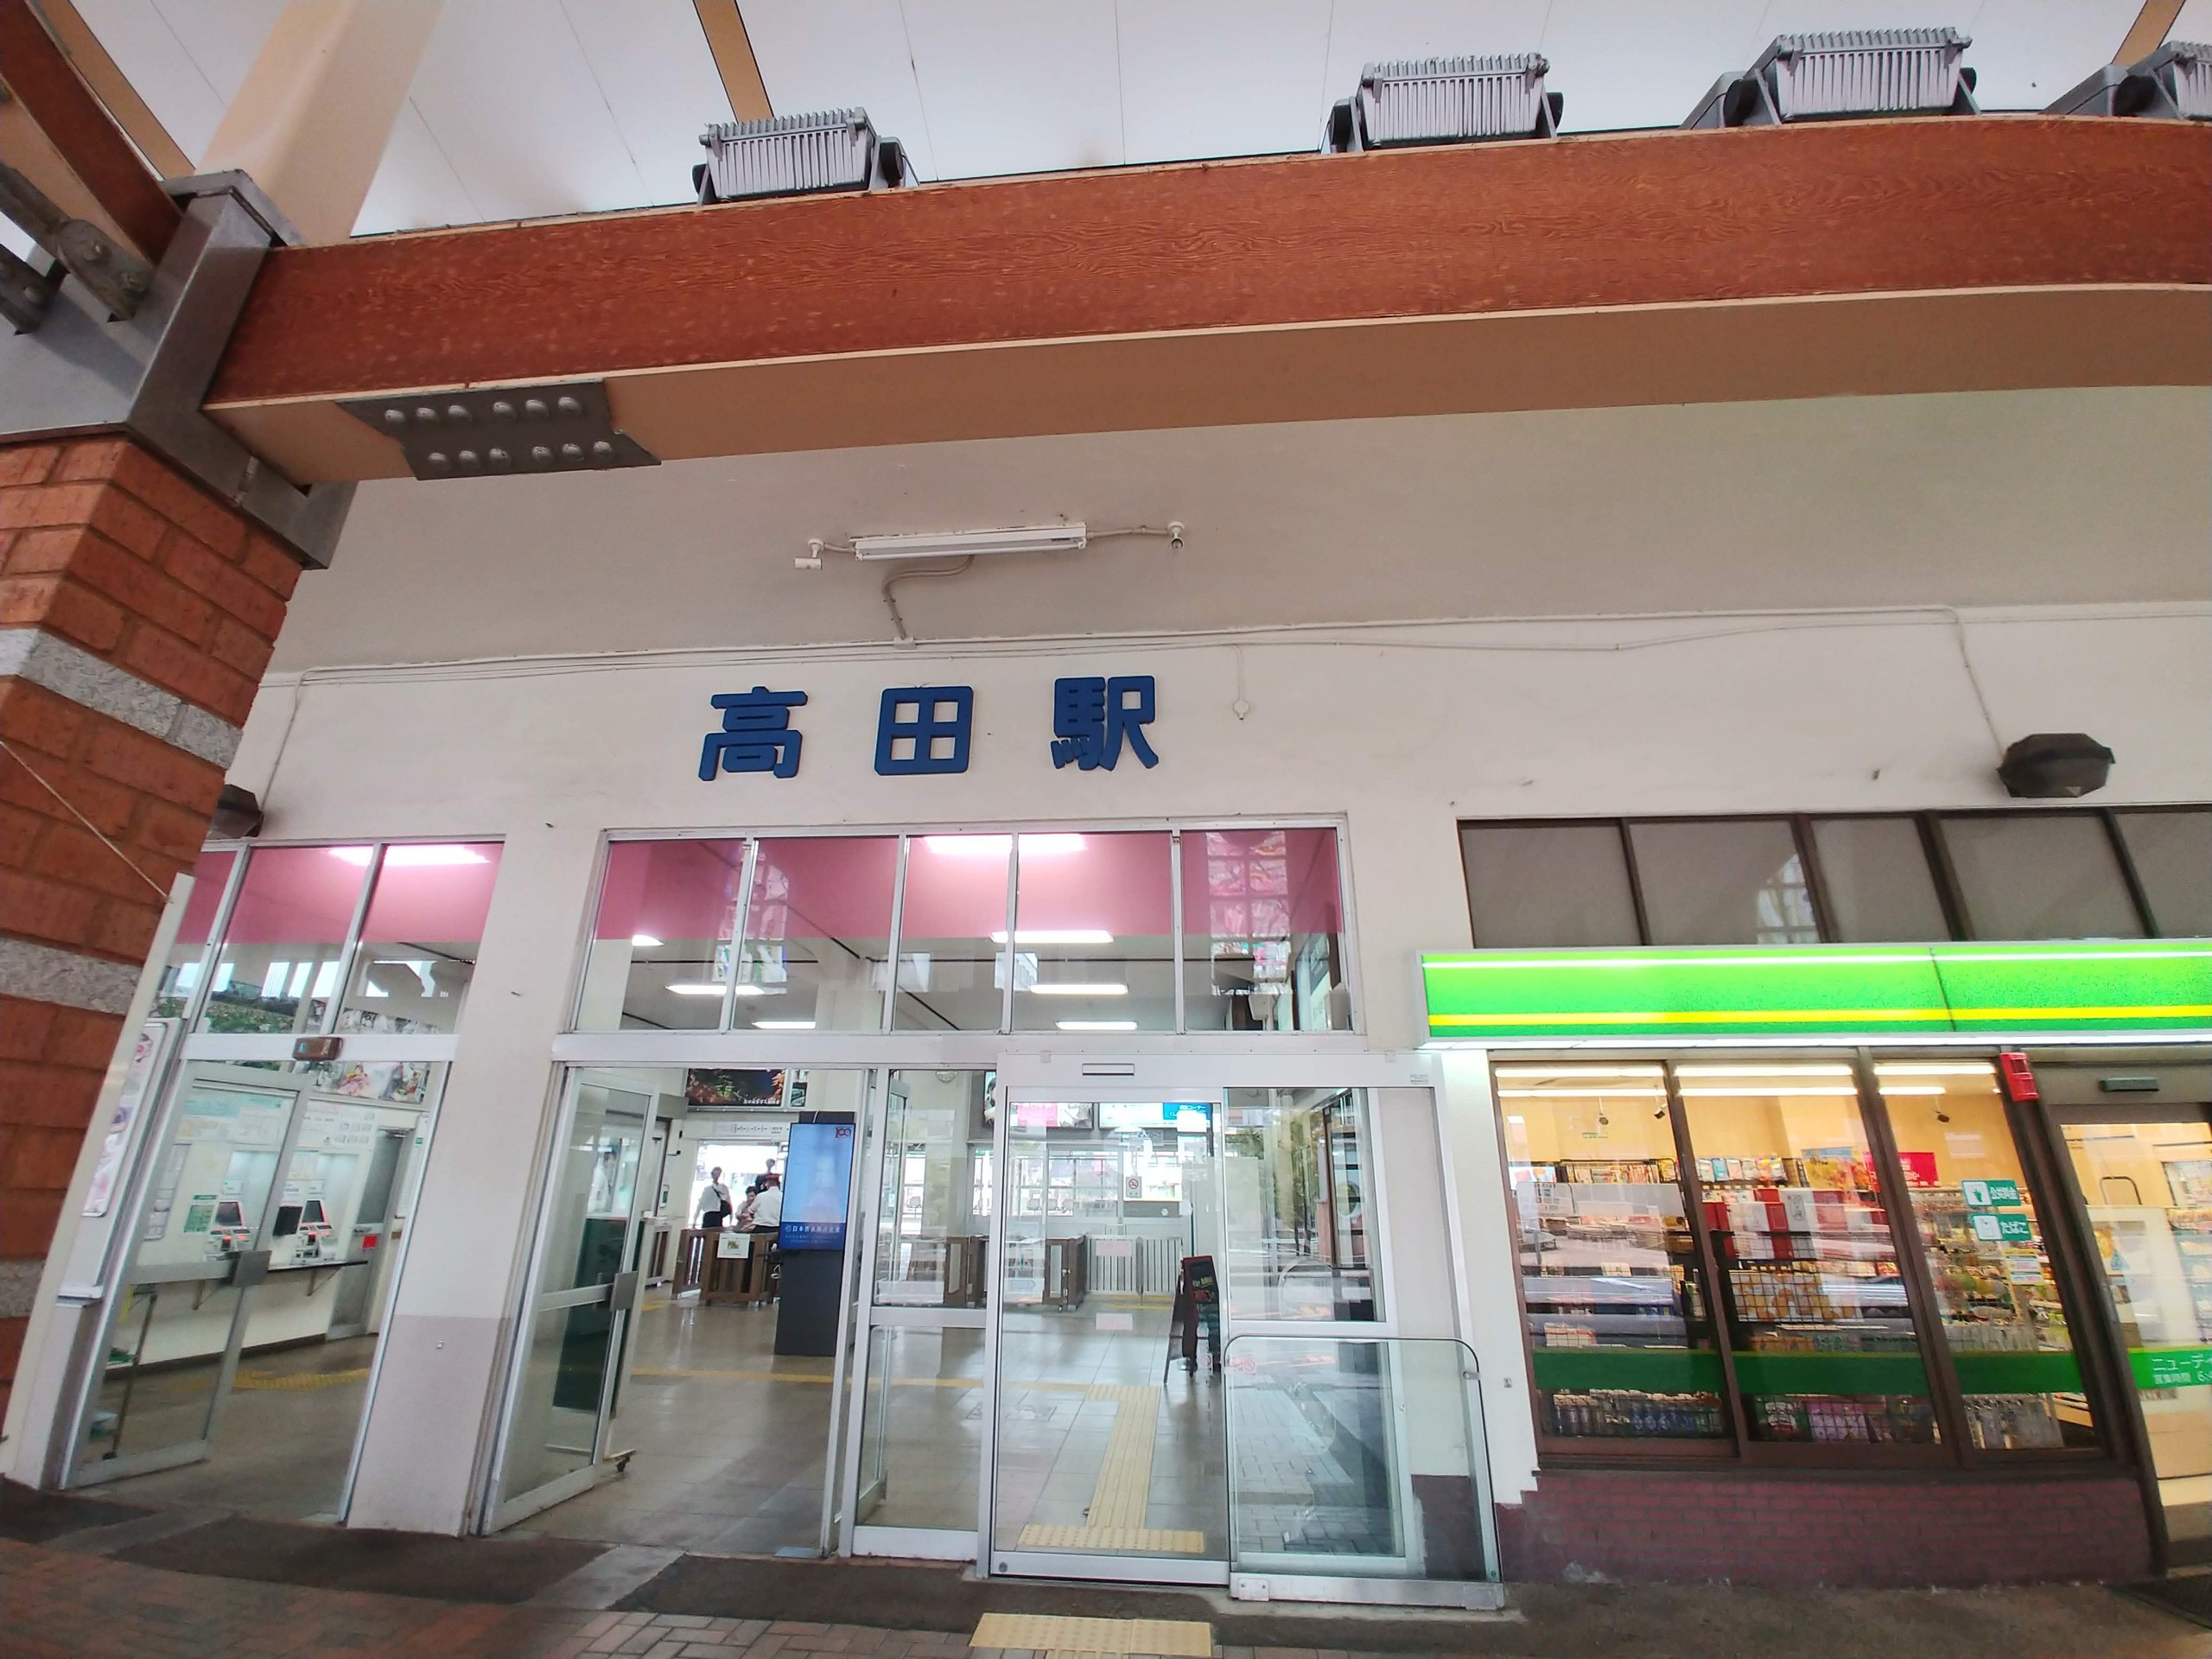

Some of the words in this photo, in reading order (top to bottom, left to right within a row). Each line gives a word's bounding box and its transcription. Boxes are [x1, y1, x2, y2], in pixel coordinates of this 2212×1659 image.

[698, 675, 1160, 781] 高田駅
[2000, 1221, 2029, 1234] たばこ
